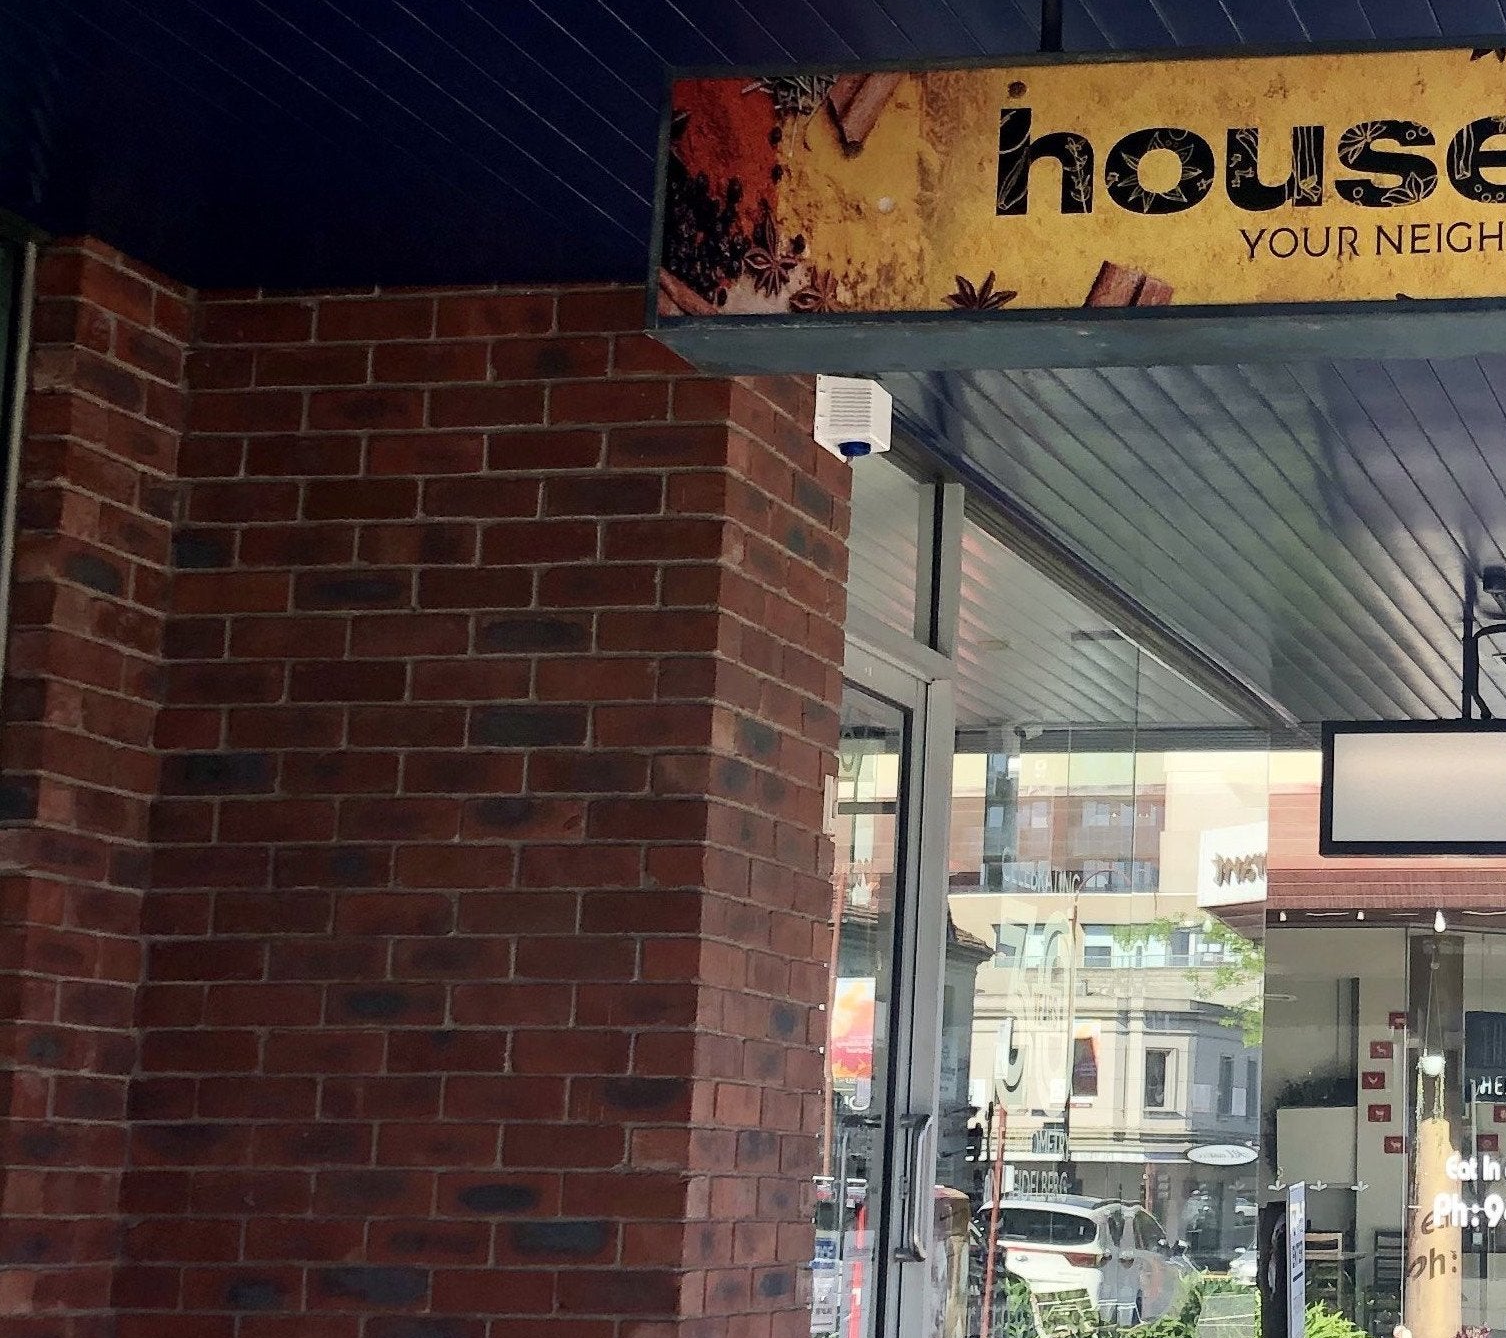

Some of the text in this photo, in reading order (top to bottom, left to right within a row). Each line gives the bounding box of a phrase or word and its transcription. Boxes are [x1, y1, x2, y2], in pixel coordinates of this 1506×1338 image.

[1240, 222, 1359, 264] YOUR
[1446, 1154, 1478, 1182] Eat
[1483, 1154, 1500, 1182] In
